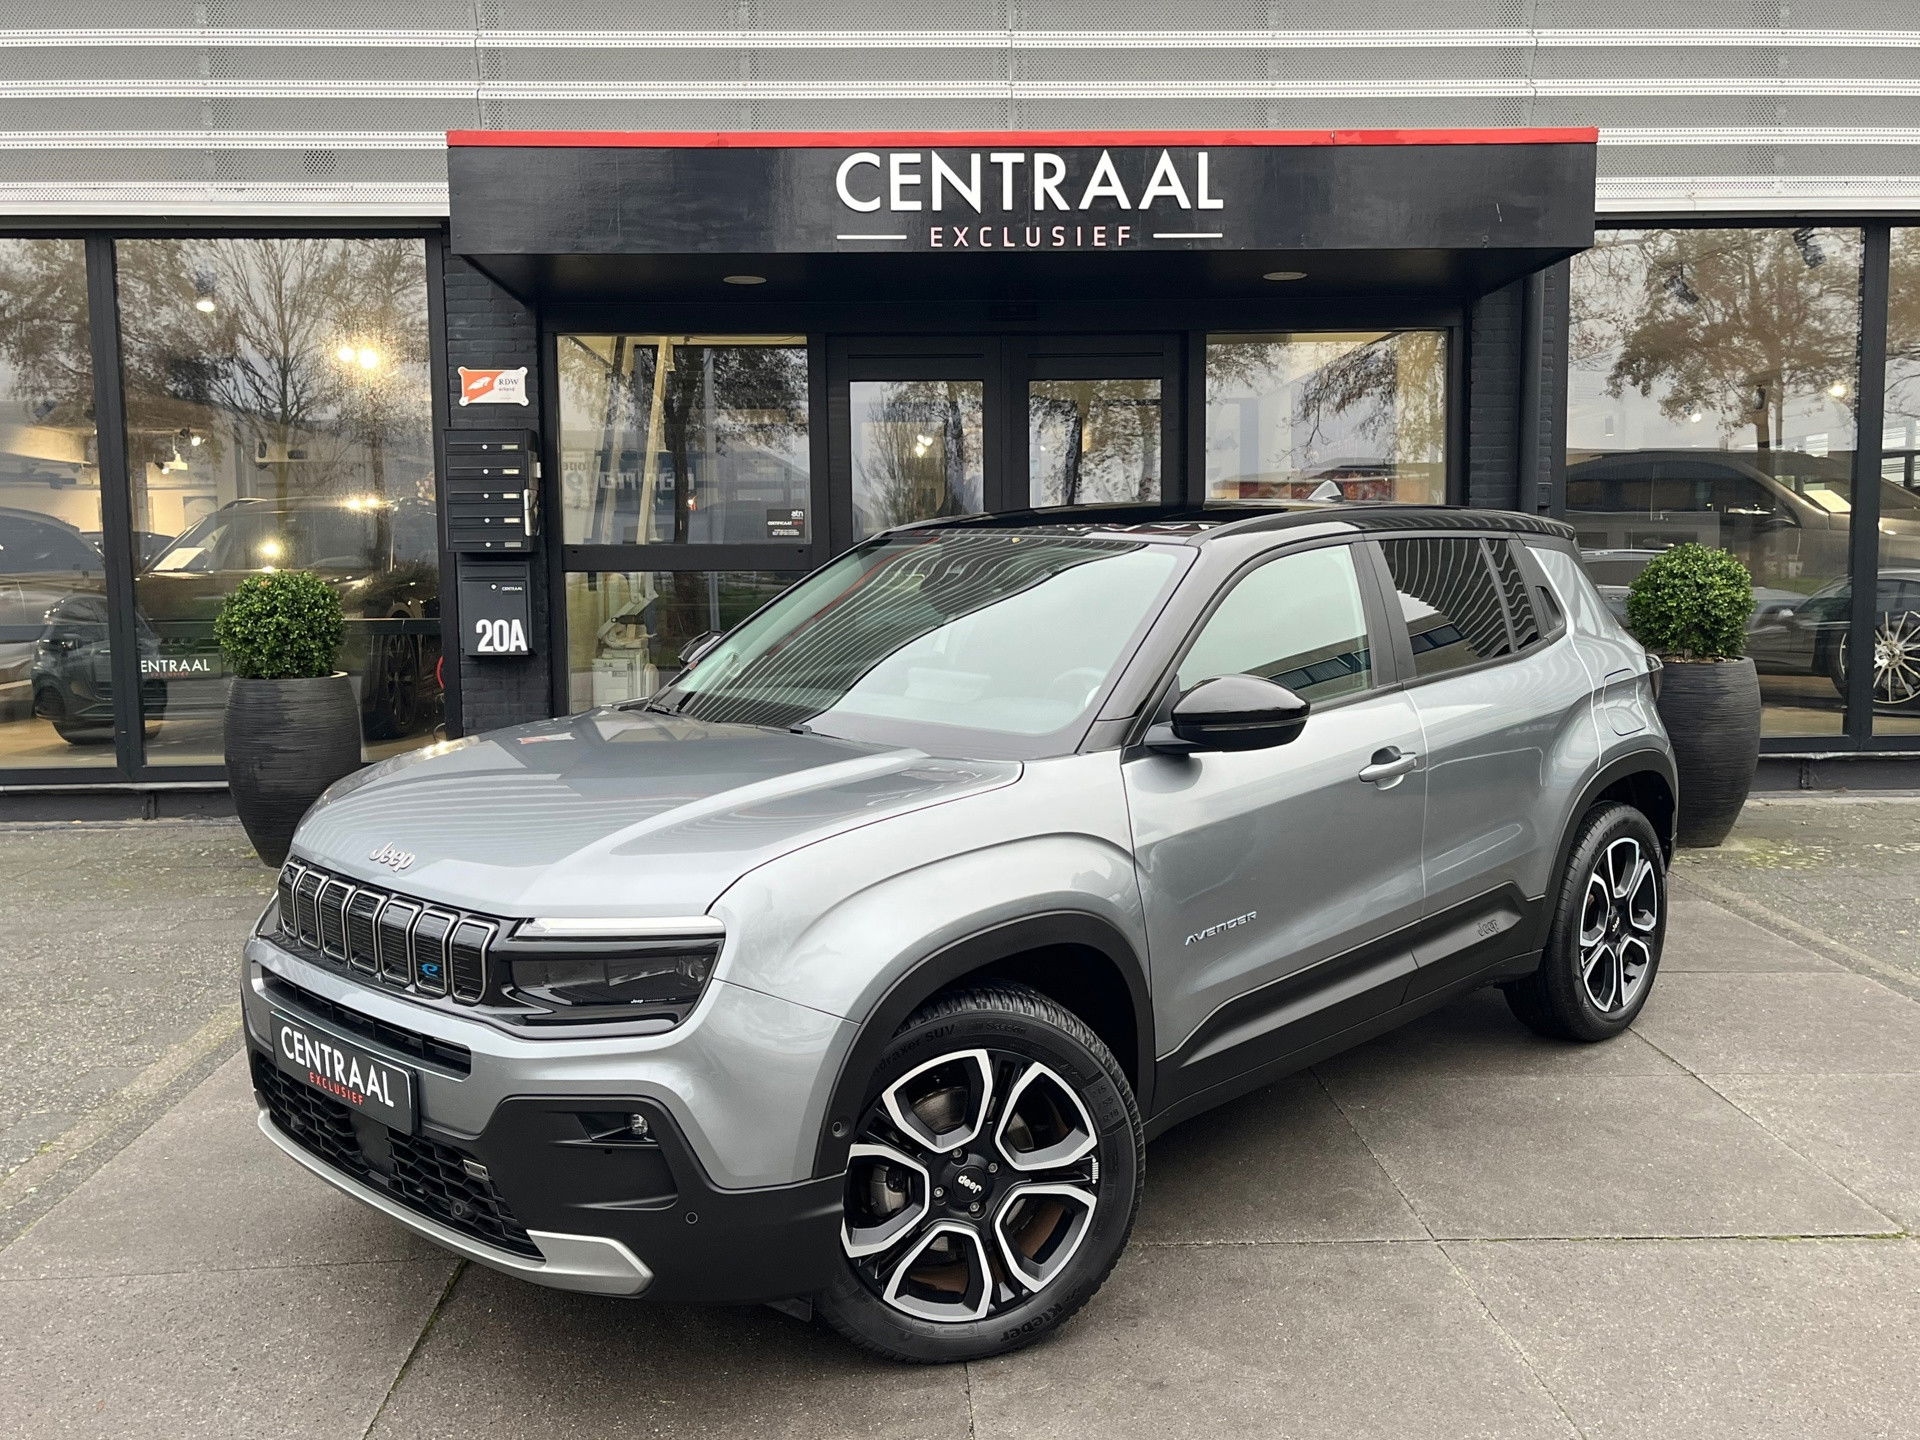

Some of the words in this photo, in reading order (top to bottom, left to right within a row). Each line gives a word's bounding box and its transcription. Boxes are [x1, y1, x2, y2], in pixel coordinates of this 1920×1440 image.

[835, 148, 1224, 214] CENTRAAL
[930, 225, 1131, 248] EXCLUSIEF
[475, 618, 528, 652] 20A
[140, 658, 211, 673] ENTRAAL
[369, 841, 416, 872] Jeep
[1184, 910, 1257, 946] AVENGER
[280, 1025, 395, 1108] CENTRAAL
[309, 1071, 364, 1106] EXCLUSIEF
